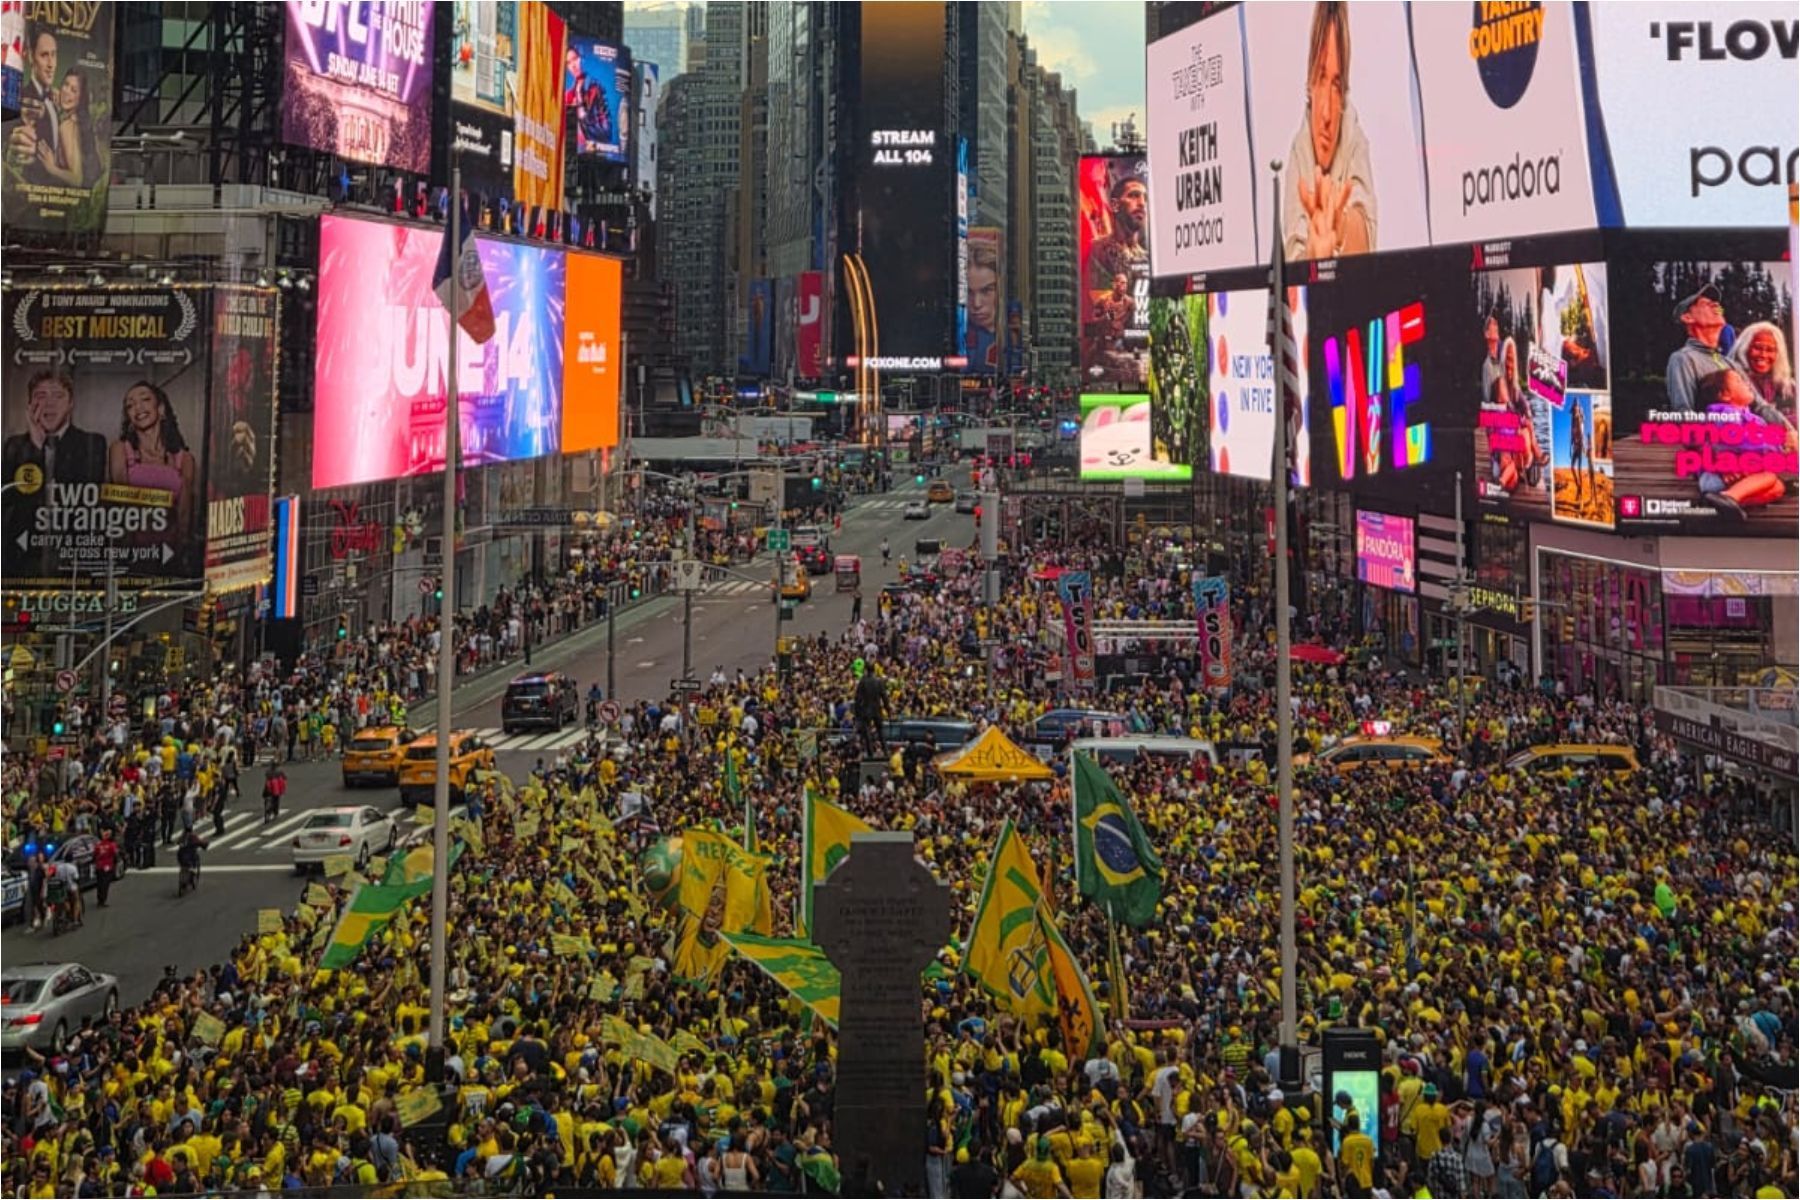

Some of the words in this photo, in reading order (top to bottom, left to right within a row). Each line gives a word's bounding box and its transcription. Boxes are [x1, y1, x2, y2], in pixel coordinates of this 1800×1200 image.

[382, 17, 424, 65] HOUSE
[1469, 7, 1546, 60] COUNTRY
[872, 130, 935, 145] STREAM
[1179, 120, 1217, 168] KEITH
[874, 149, 903, 163] ALL
[904, 149, 933, 164] 104
[1175, 164, 1222, 212] URBAN
[1462, 151, 1561, 216] pandora
[1175, 213, 1223, 256] pandora
[53, 294, 74, 307] TONY
[109, 294, 169, 307] NOMINATIONS
[42, 316, 87, 339] BEST
[88, 315, 167, 339] MUSICAL
[863, 356, 941, 369] FOXONE.COM
[1232, 355, 1251, 378] NEW
[1254, 355, 1274, 379] YOR
[1251, 388, 1273, 413] FIVE
[1648, 409, 1682, 422] From
[1684, 410, 1705, 422] the
[1708, 411, 1742, 422] most
[1639, 422, 1787, 446] remote
[51, 478, 99, 507] two
[35, 504, 168, 538] strangers
[30, 534, 62, 548] carry
[64, 536, 73, 547] a
[75, 533, 105, 547] cake
[59, 548, 100, 559] across
[103, 549, 129, 560] new
[131, 544, 160, 562] york
[20, 595, 138, 613] LUGGAE
[1471, 586, 1517, 615] SEPHORA
[1672, 718, 1721, 746] AMERICAN
[1726, 735, 1759, 760] EAGLE
